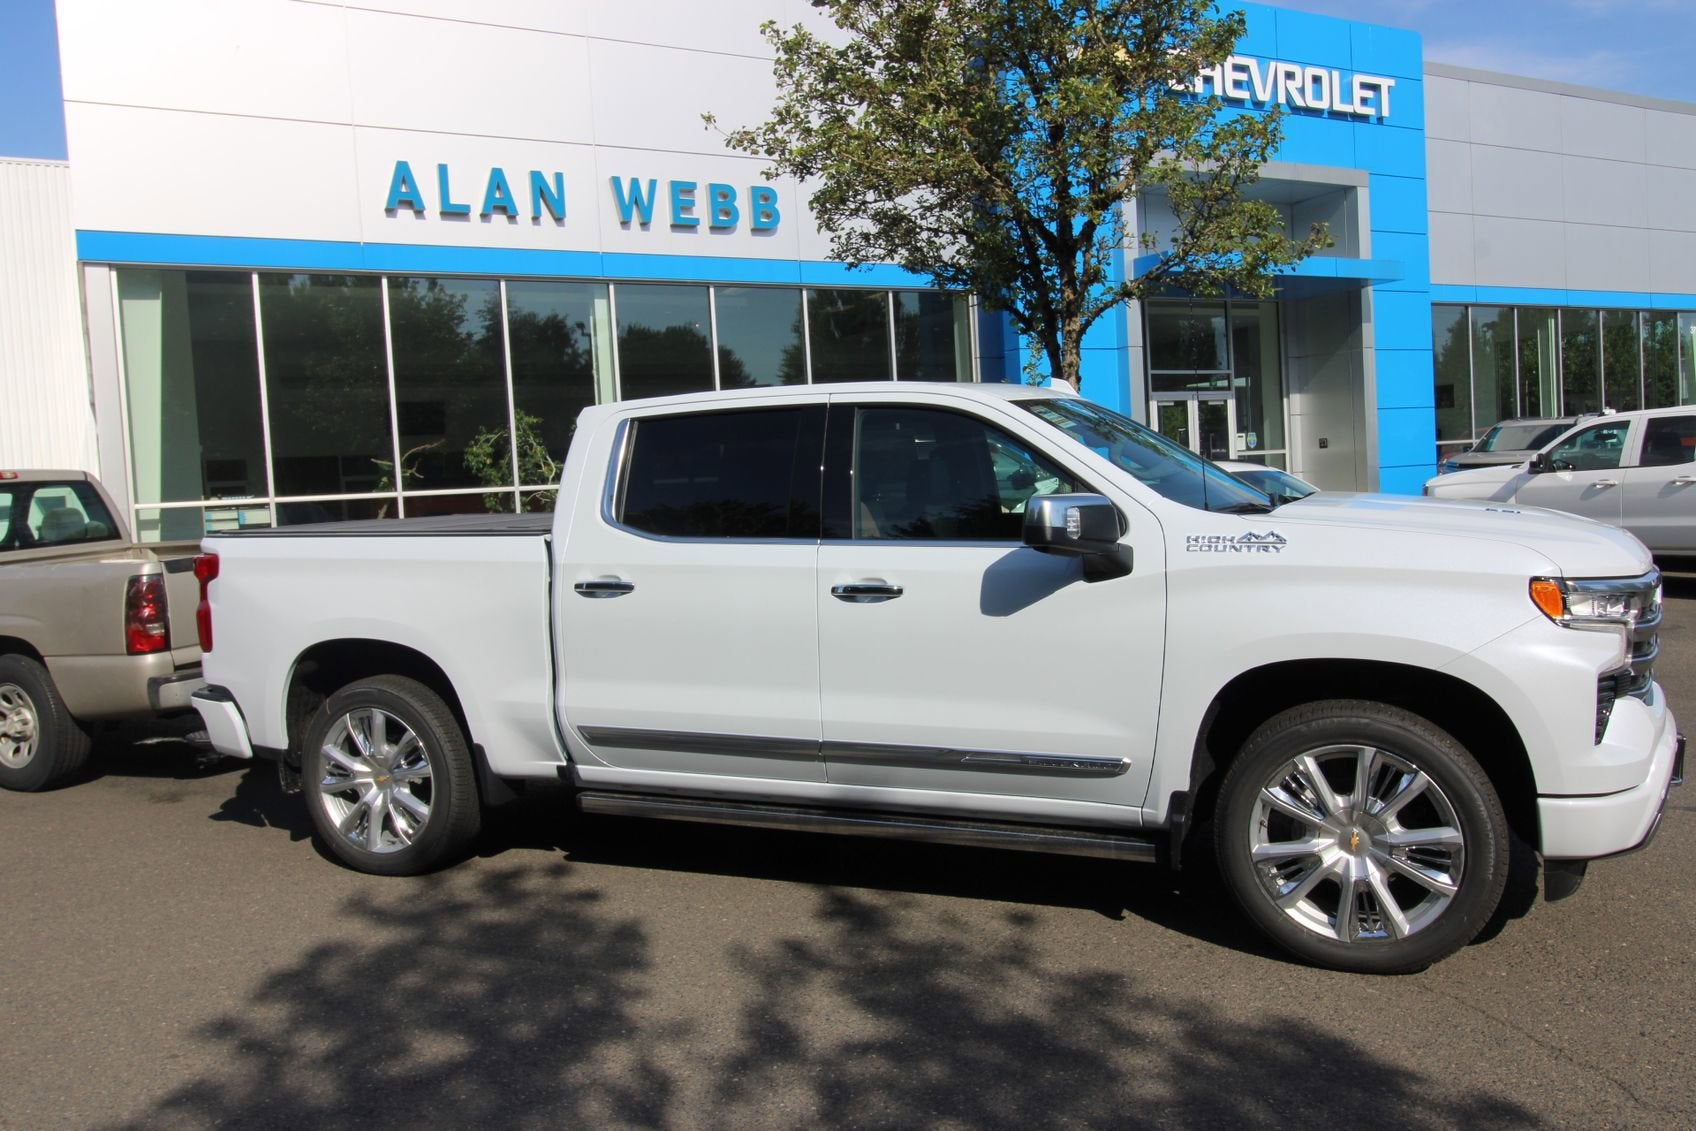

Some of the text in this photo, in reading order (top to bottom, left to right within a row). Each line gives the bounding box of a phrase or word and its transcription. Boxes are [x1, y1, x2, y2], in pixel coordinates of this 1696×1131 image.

[384, 160, 781, 231] ALAN WEBB
[1186, 535, 1237, 544] HIGH
[1186, 544, 1286, 553] COUNTRY
